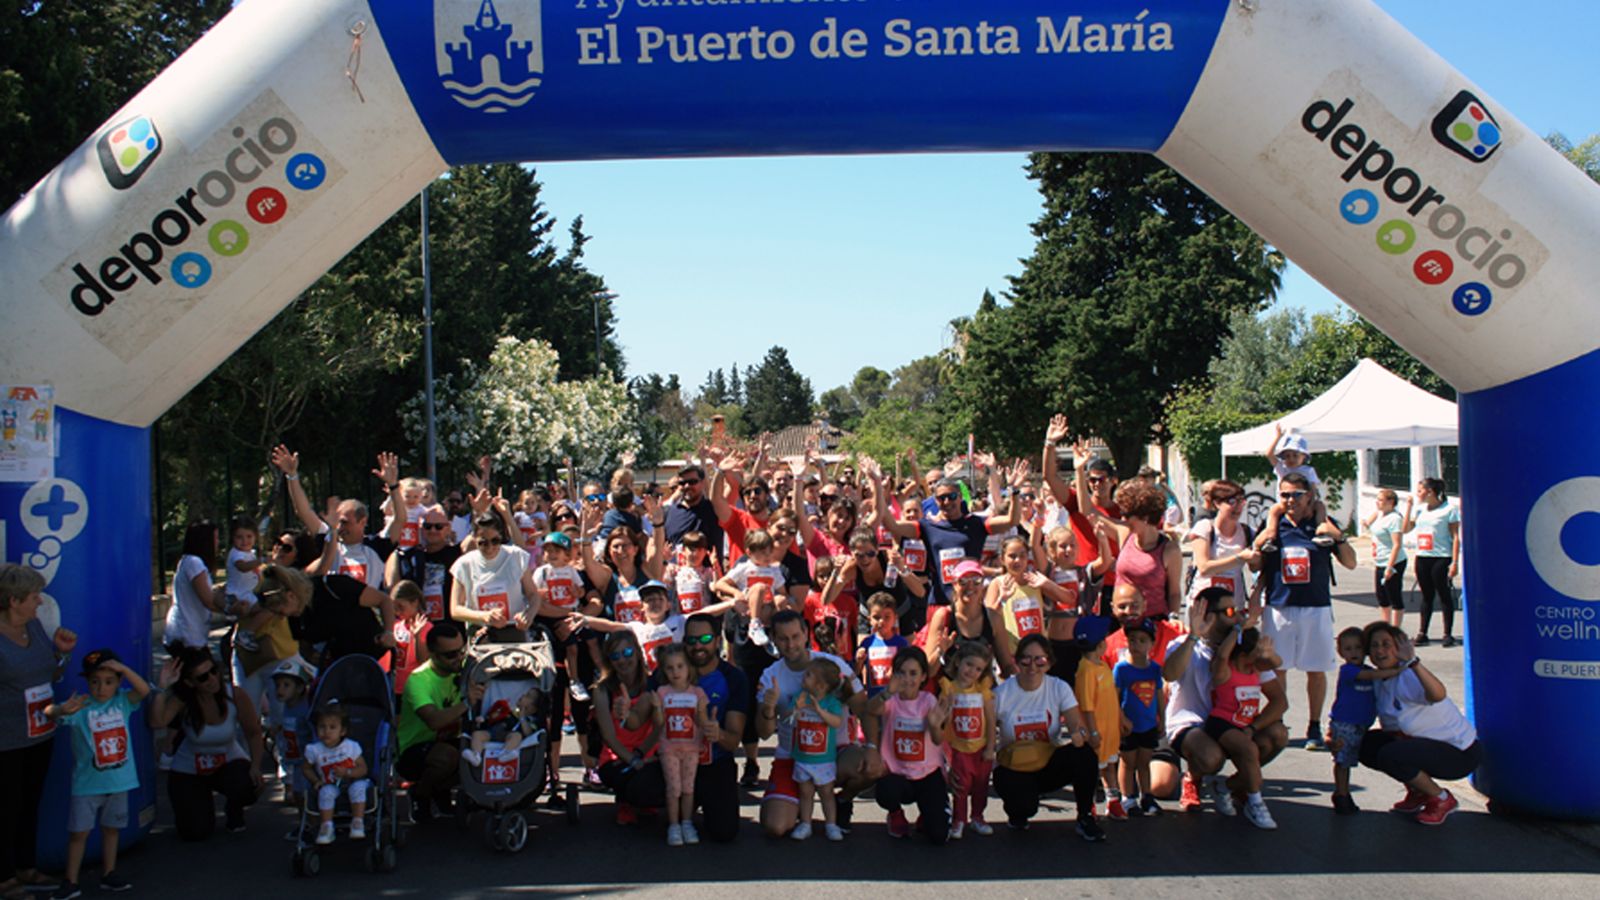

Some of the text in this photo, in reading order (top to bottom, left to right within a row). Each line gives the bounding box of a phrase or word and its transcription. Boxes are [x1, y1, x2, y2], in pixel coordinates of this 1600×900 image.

[576, 8, 1174, 65] El Puerto de Santa María
[1301, 98, 1527, 289] deporocio
[70, 117, 297, 317] deporocio
[1535, 605, 1596, 620] CENTRO
[1536, 620, 1600, 640] welln
[1543, 662, 1558, 676] EL
